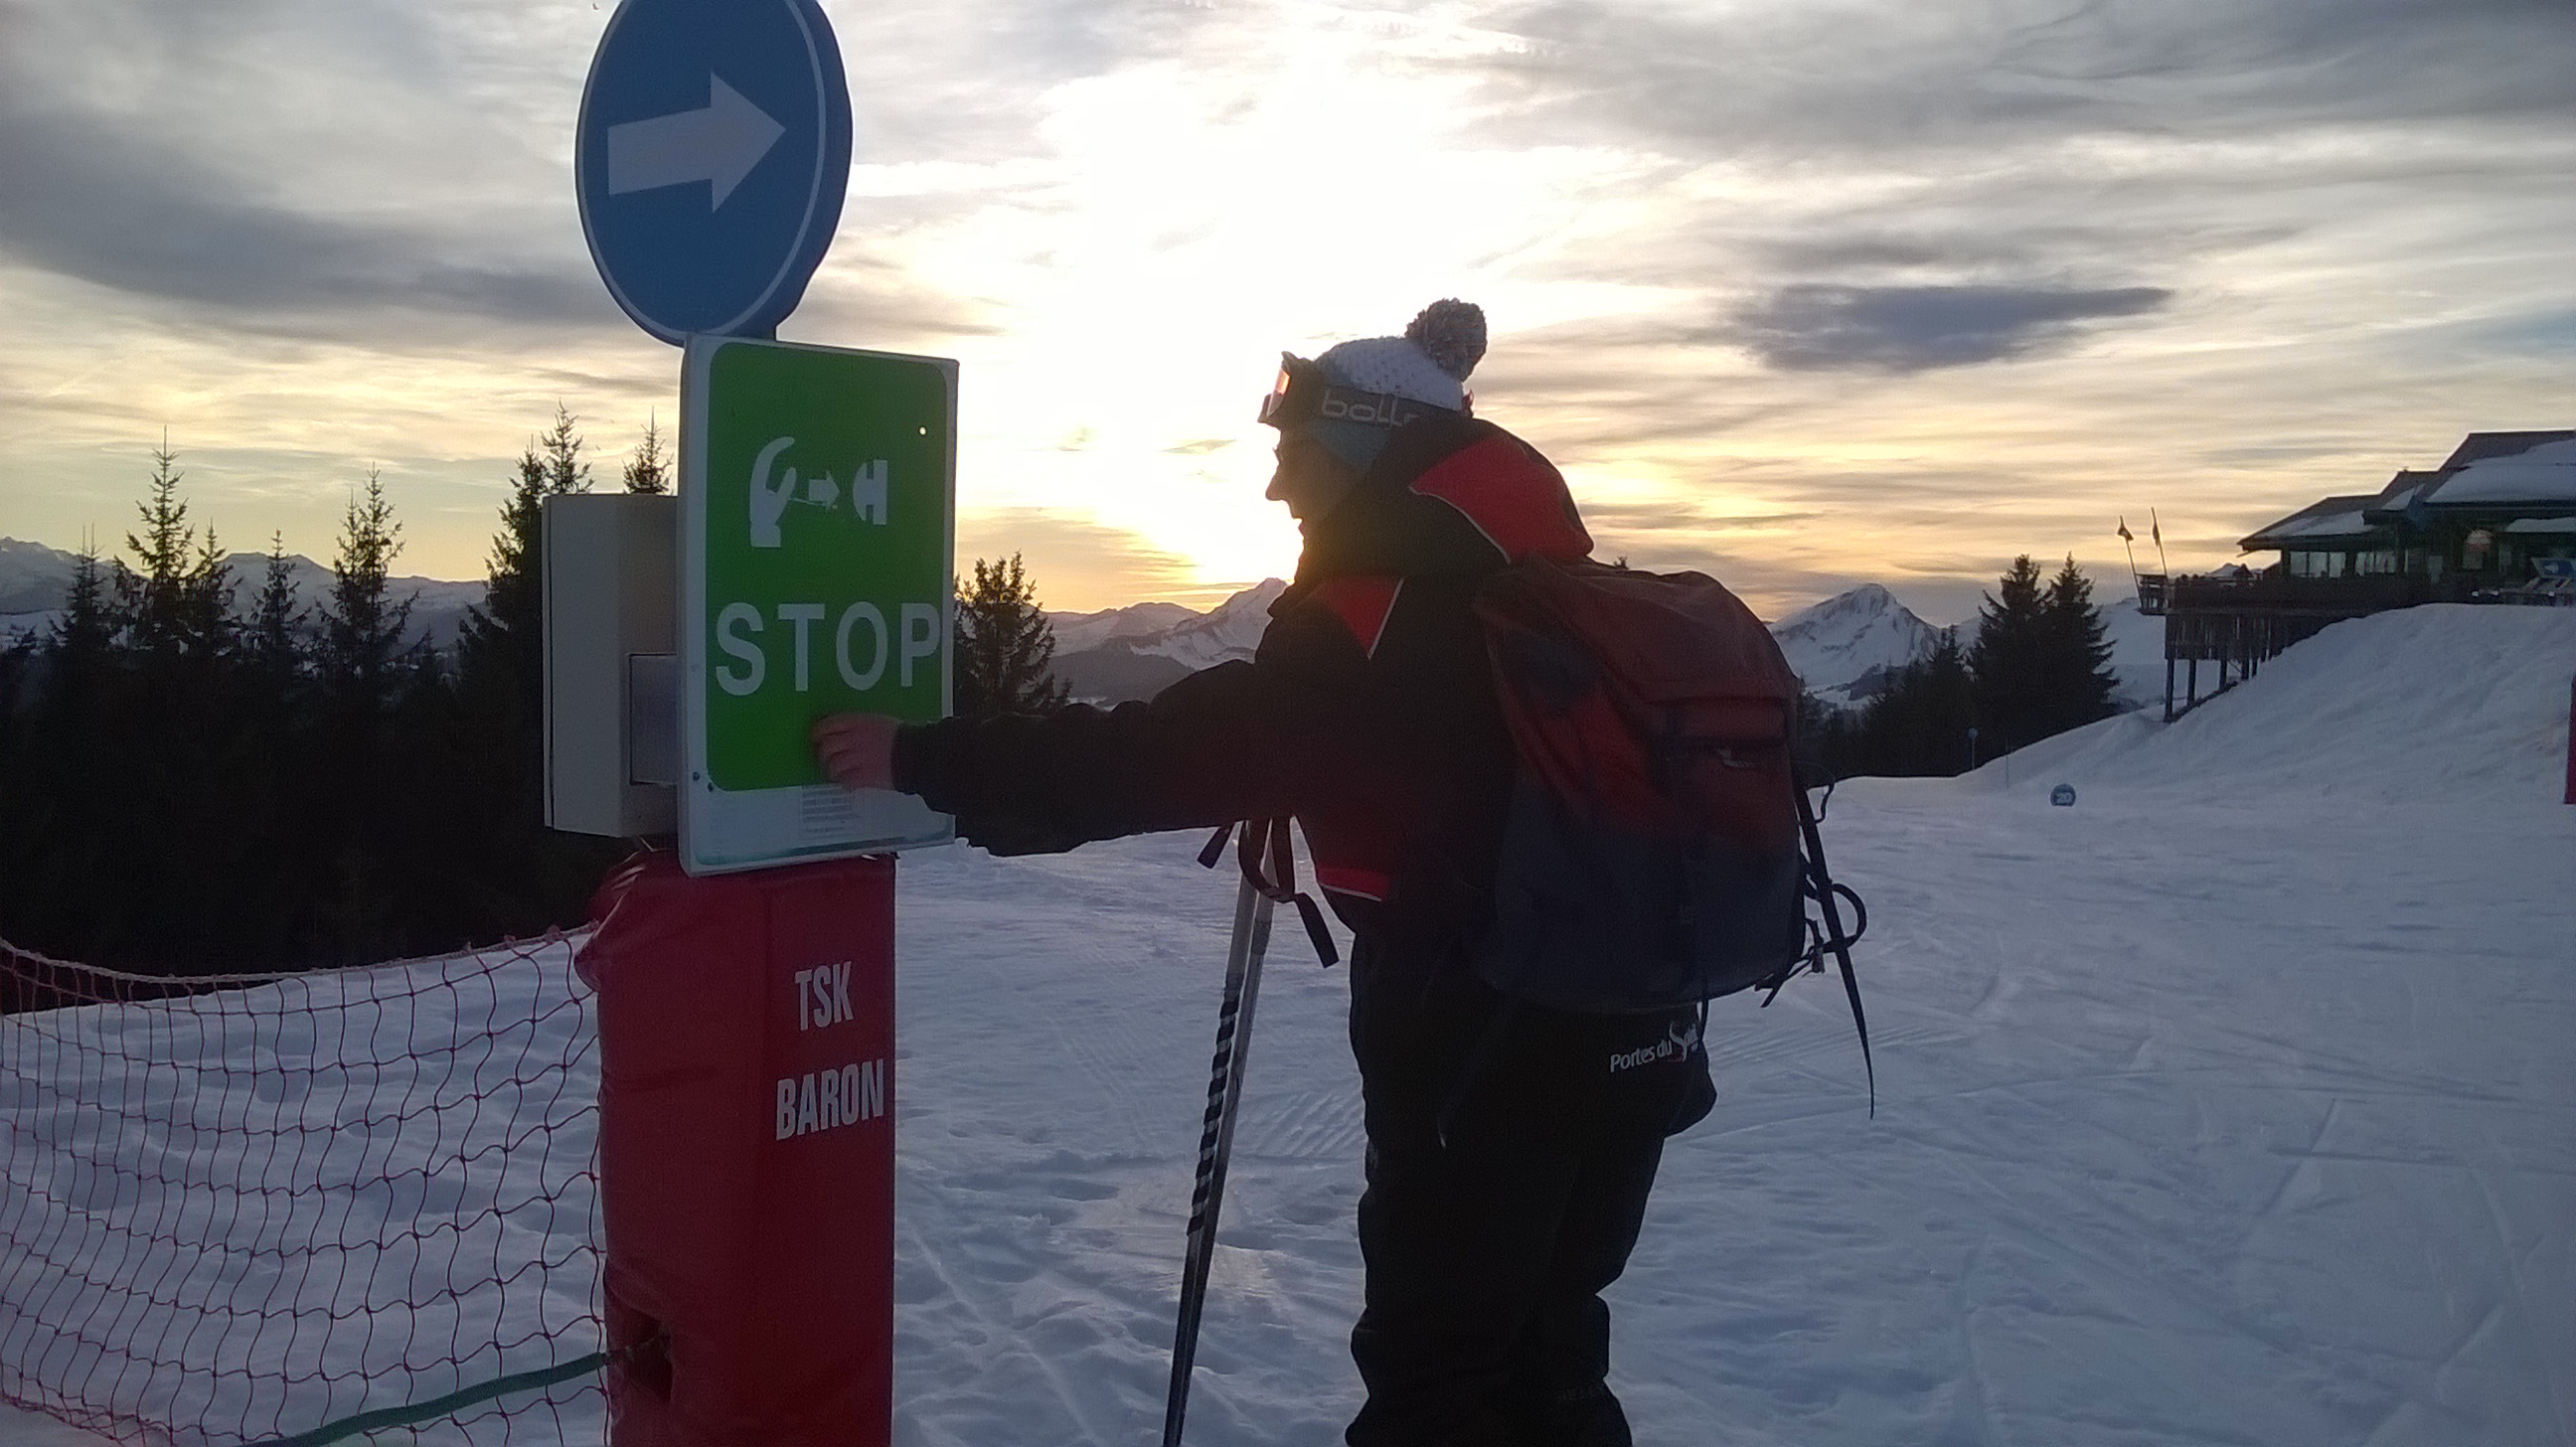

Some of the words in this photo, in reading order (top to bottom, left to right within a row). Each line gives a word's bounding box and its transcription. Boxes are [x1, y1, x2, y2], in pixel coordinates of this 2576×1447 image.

[716, 601, 940, 696] STOP
[795, 961, 854, 1032] TSK
[1610, 1046, 1655, 1073] Portes
[1657, 1040, 1673, 1057] du
[776, 1058, 884, 1140] BARON
